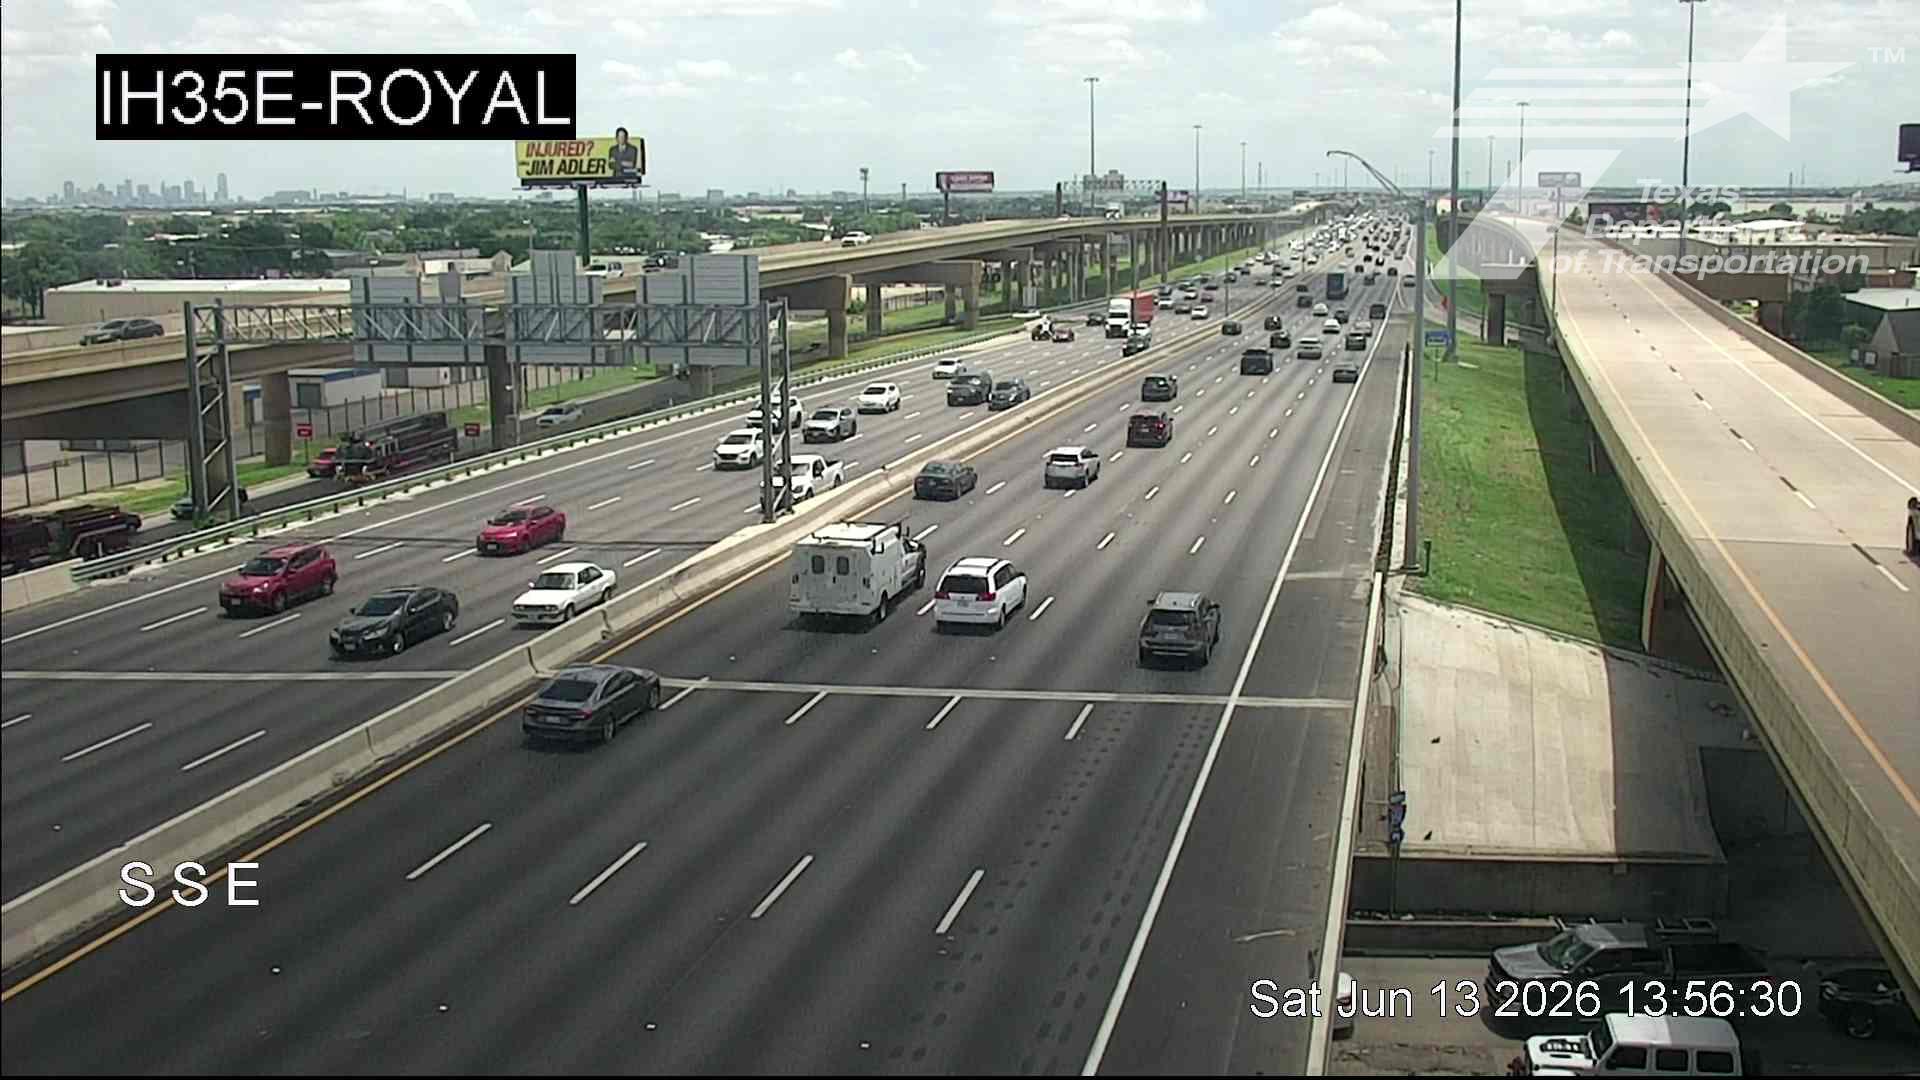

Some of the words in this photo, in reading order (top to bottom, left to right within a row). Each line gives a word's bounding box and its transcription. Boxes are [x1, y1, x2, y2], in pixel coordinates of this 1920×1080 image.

[526, 141, 594, 158] INJURED?
[526, 160, 554, 176] JIM
[556, 158, 606, 175] ADLER
